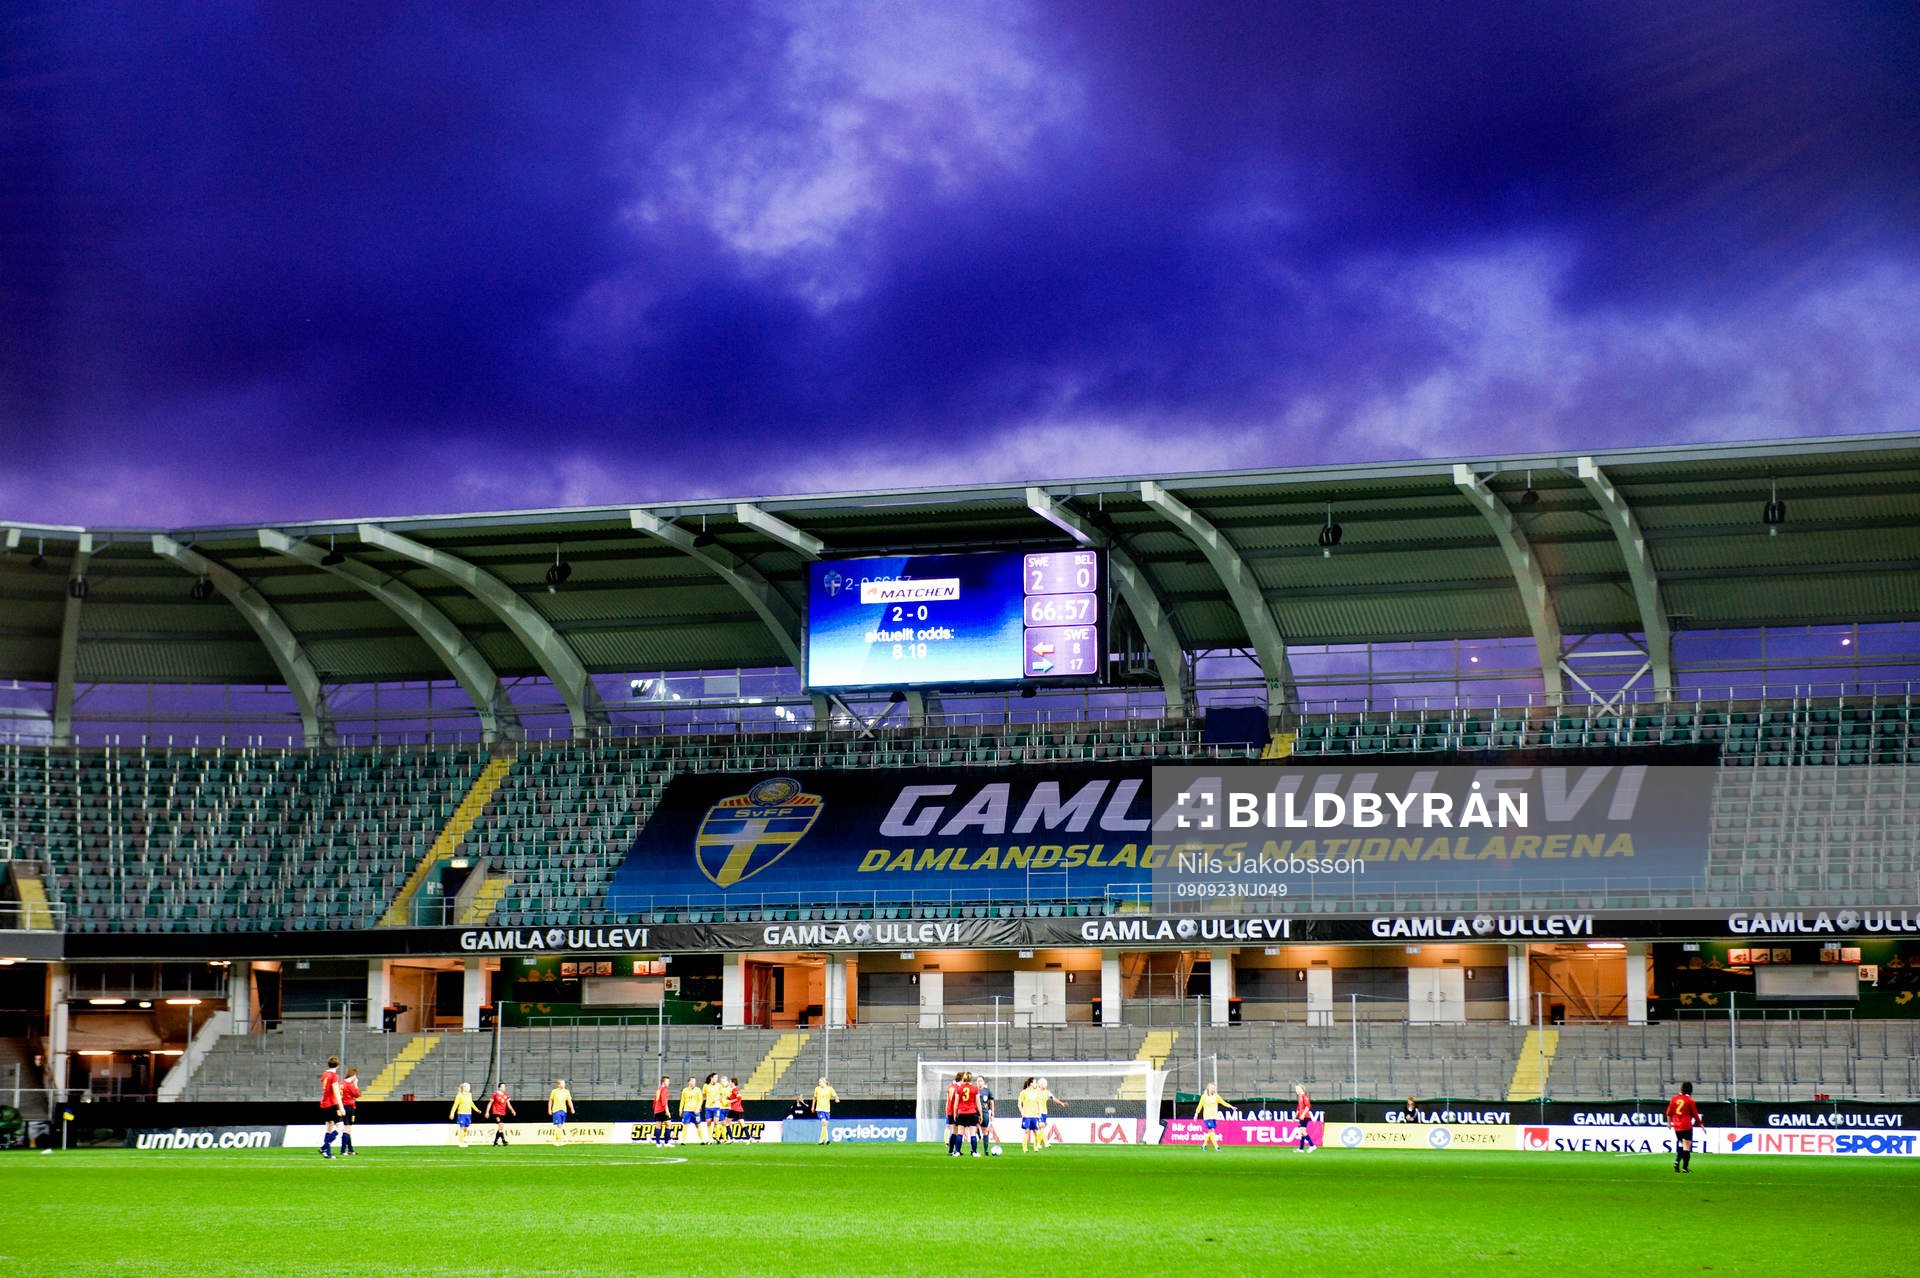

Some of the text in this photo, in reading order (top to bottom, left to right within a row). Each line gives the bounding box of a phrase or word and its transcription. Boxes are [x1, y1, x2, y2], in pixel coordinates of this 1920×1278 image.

[1028, 556, 1049, 567] SWE
[1031, 570, 1044, 590] 2
[1076, 568, 1090, 588] 0
[881, 587, 954, 599] MATCHEN
[892, 606, 903, 621] 2
[917, 605, 928, 620] 0
[1031, 599, 1090, 621] 66:57
[864, 626, 955, 643] aktuellt odds:
[1064, 628, 1090, 640] SWE
[1070, 658, 1084, 670] 17
[735, 808, 793, 818] SvFF
[879, 777, 1222, 837] GAMLA
[857, 833, 1635, 873] DAMLANDSLAGETS NATIONALARENA
[1081, 919, 1291, 941] GAMLA ULLEVI
[1371, 914, 1594, 937] GAMLA ULLEVI
[1728, 911, 1835, 933] GAMLA
[460, 928, 649, 950] GAMLA ULLEVI
[763, 923, 961, 945] GAMLA ULLEVI
[962, 1087, 970, 1102] 3
[1676, 1099, 1685, 1115] 2
[1217, 1110, 1324, 1122] AMLA ULLVI
[1385, 1111, 1510, 1124] GALA ULLEVI
[1573, 1112, 1631, 1125] GAMLA
[1768, 1114, 1903, 1127] GAMLA ULLEVI
[136, 1128, 272, 1149] umbro.com
[537, 1128, 567, 1136] FORX
[1090, 1122, 1128, 1144] ICA
[1365, 1132, 1408, 1142] POSTEN
[1453, 1133, 1497, 1143] POSTEN
[1554, 1138, 1712, 1153] SVENSKA SEL
[1758, 1133, 1916, 1154] INTERSPORT
